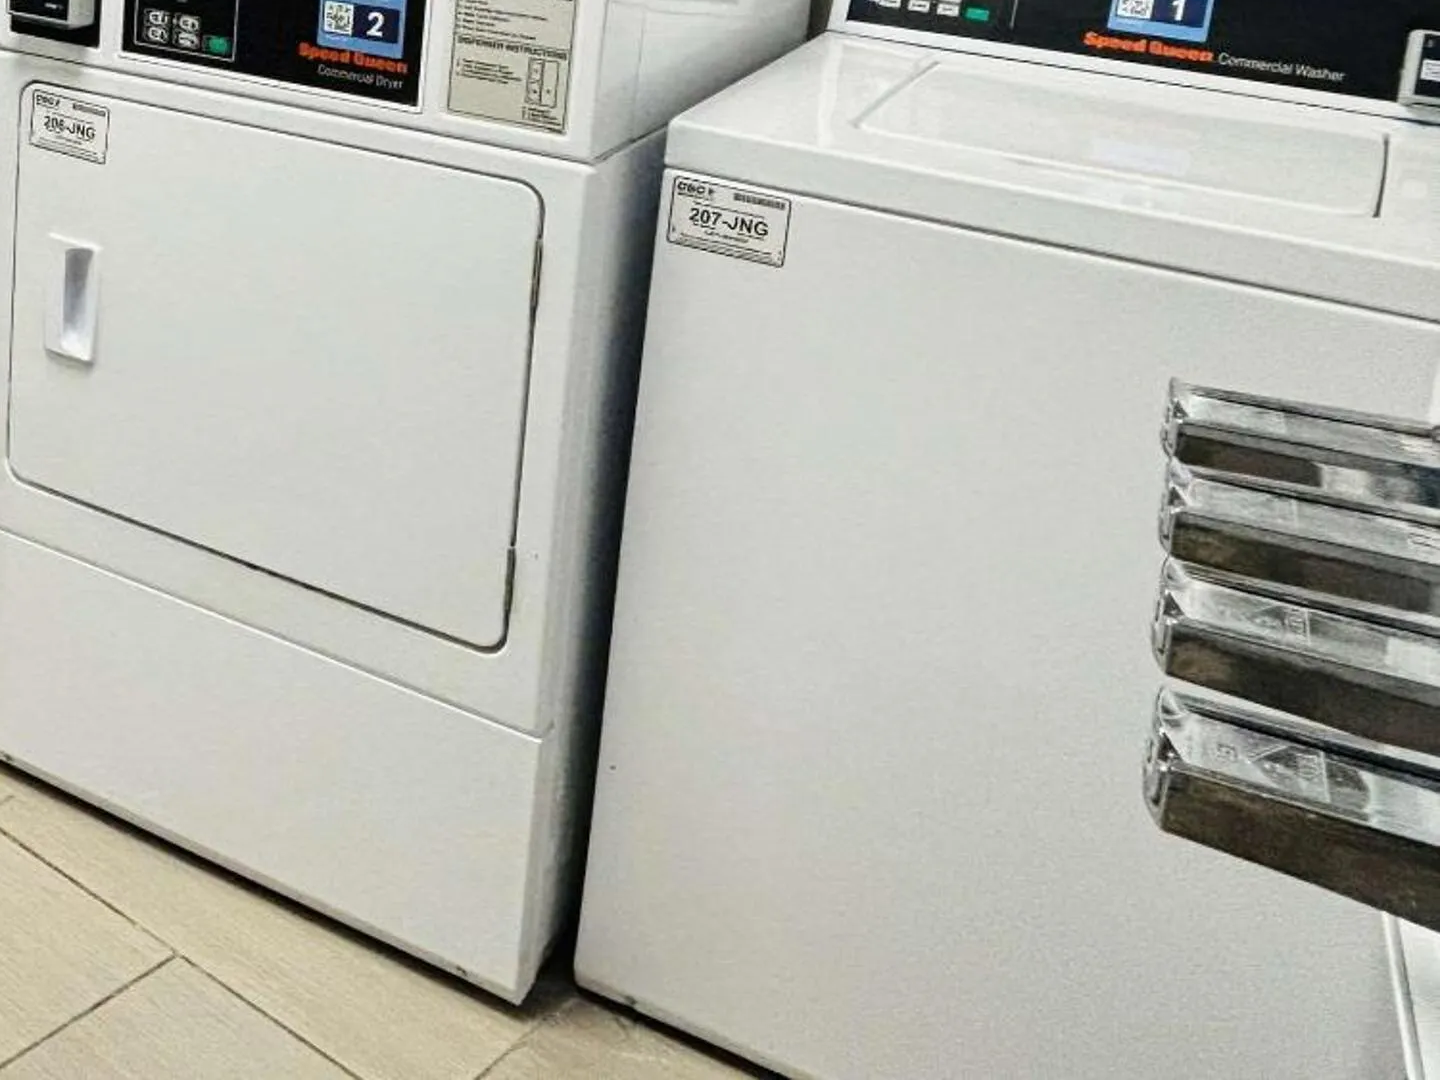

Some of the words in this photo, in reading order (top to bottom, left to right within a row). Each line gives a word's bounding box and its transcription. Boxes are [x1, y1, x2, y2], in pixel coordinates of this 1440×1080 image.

[365, 11, 385, 38] 2
[297, 41, 351, 64] Speed
[353, 50, 409, 75] Queen
[1083, 31, 1148, 53] Speed
[1148, 39, 1214, 63] Queen
[1217, 51, 1294, 76] Commercial
[1294, 62, 1346, 83] Washer
[317, 63, 375, 86] Commercial
[375, 74, 405, 90] Dryer
[687, 206, 770, 237] 207-JNG
